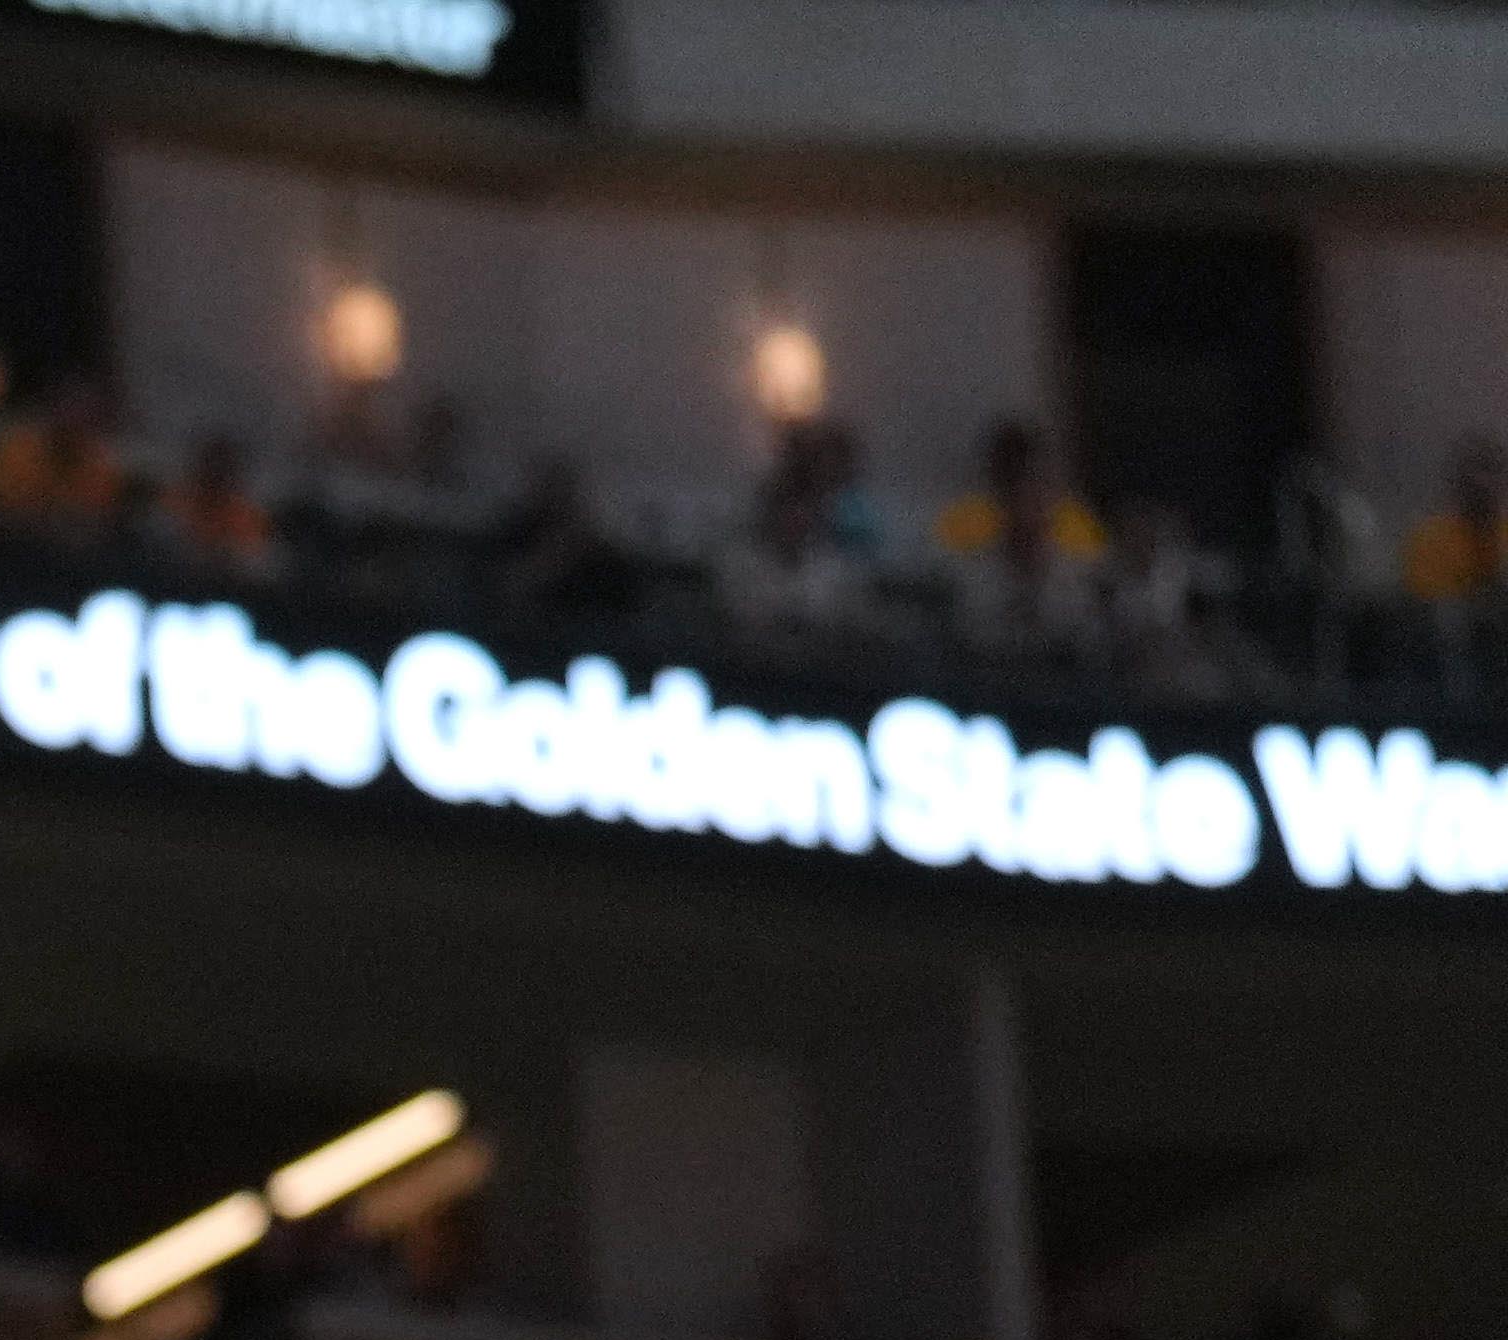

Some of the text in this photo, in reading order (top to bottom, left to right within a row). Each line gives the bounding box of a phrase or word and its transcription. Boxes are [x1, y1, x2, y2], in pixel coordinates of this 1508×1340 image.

[141, 602, 388, 788] the
[384, 632, 873, 853] Golden
[867, 697, 1260, 886] State
[1253, 726, 1508, 893] Wa
